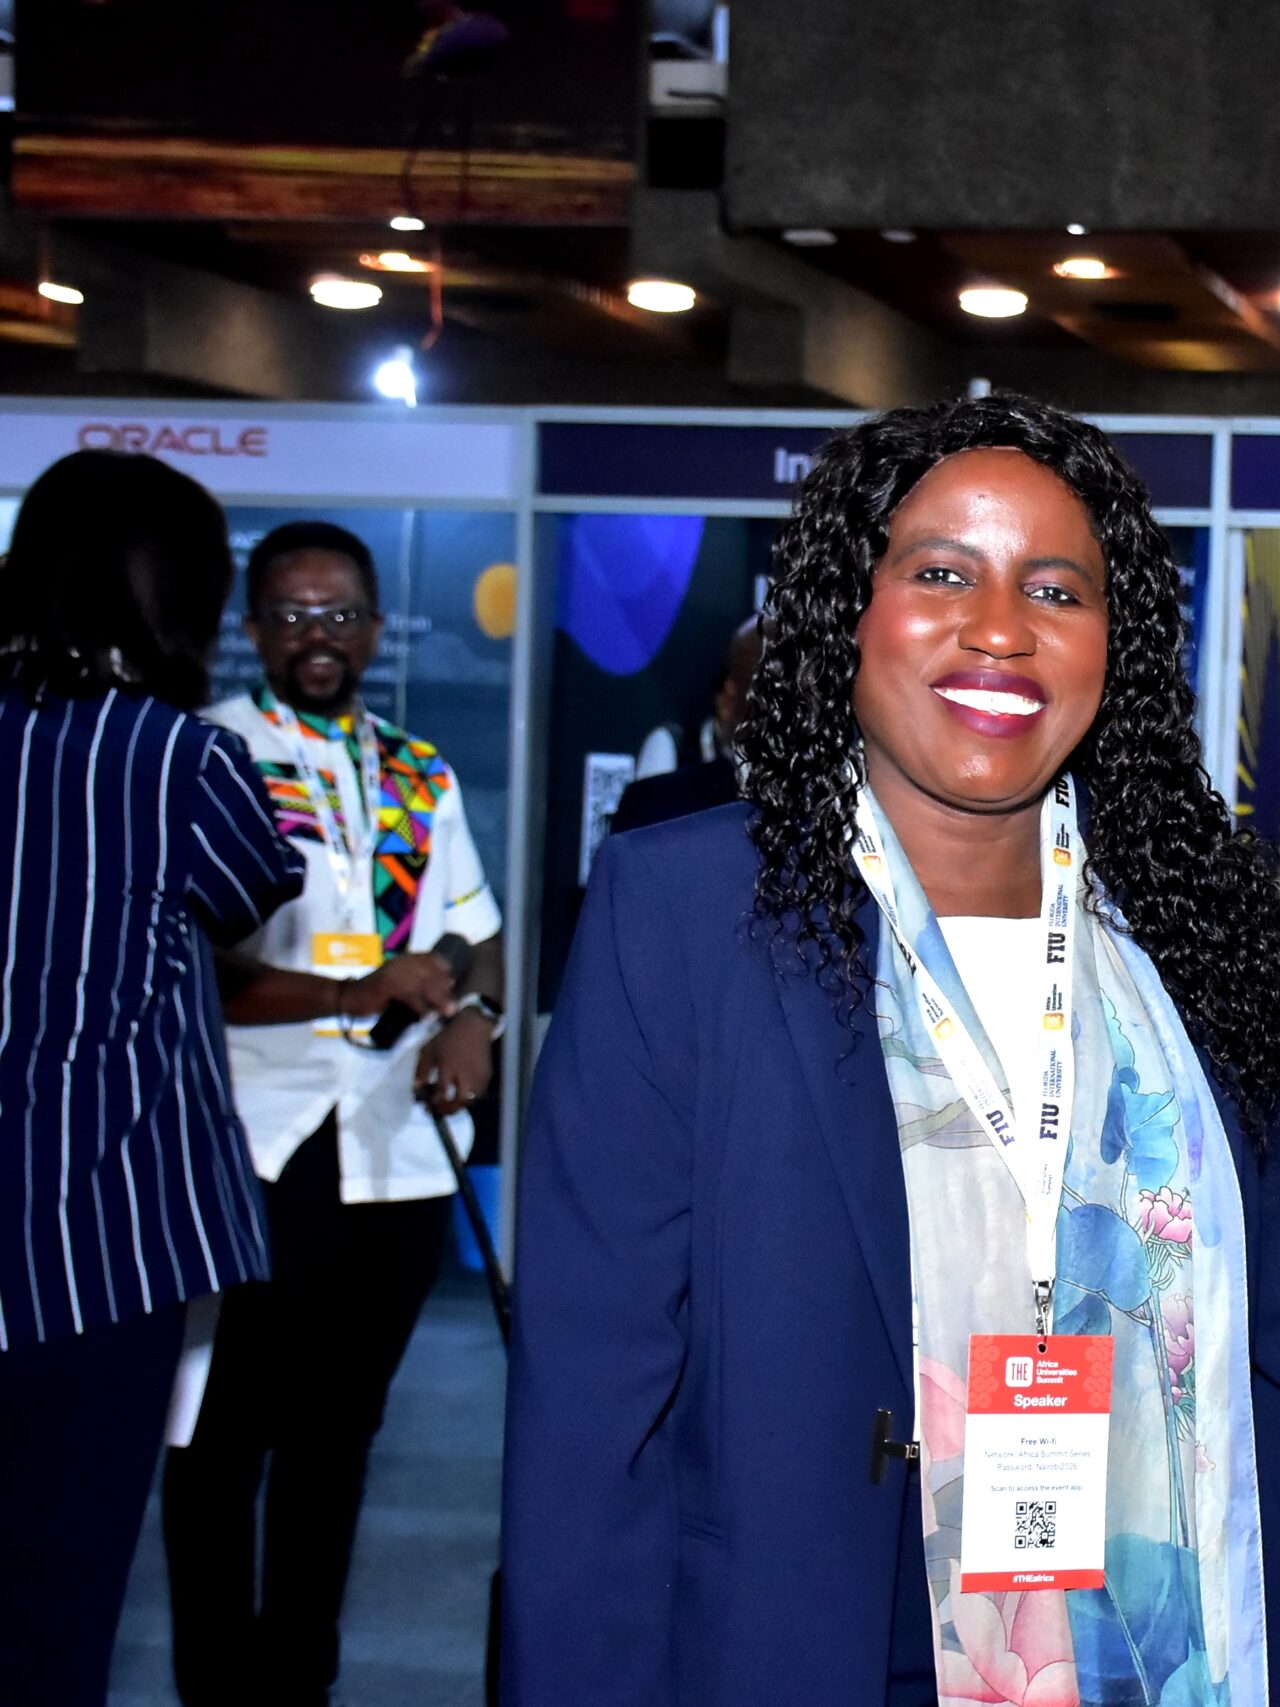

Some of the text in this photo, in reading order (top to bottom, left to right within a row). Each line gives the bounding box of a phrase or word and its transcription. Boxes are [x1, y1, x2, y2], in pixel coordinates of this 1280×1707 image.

[77, 423, 269, 456] ORACLE
[1055, 776, 1070, 808] FIU
[1046, 932, 1066, 964] FIU
[986, 1109, 1015, 1147] FIU
[1039, 1102, 1060, 1140] FIU
[1011, 1362, 1029, 1381] THE
[1036, 1360, 1059, 1368] Africa
[1036, 1368, 1078, 1376] Universities
[1036, 1376, 1064, 1384] Summit
[1013, 1393, 1068, 1409] Speaker
[1021, 1437, 1037, 1446] Free
